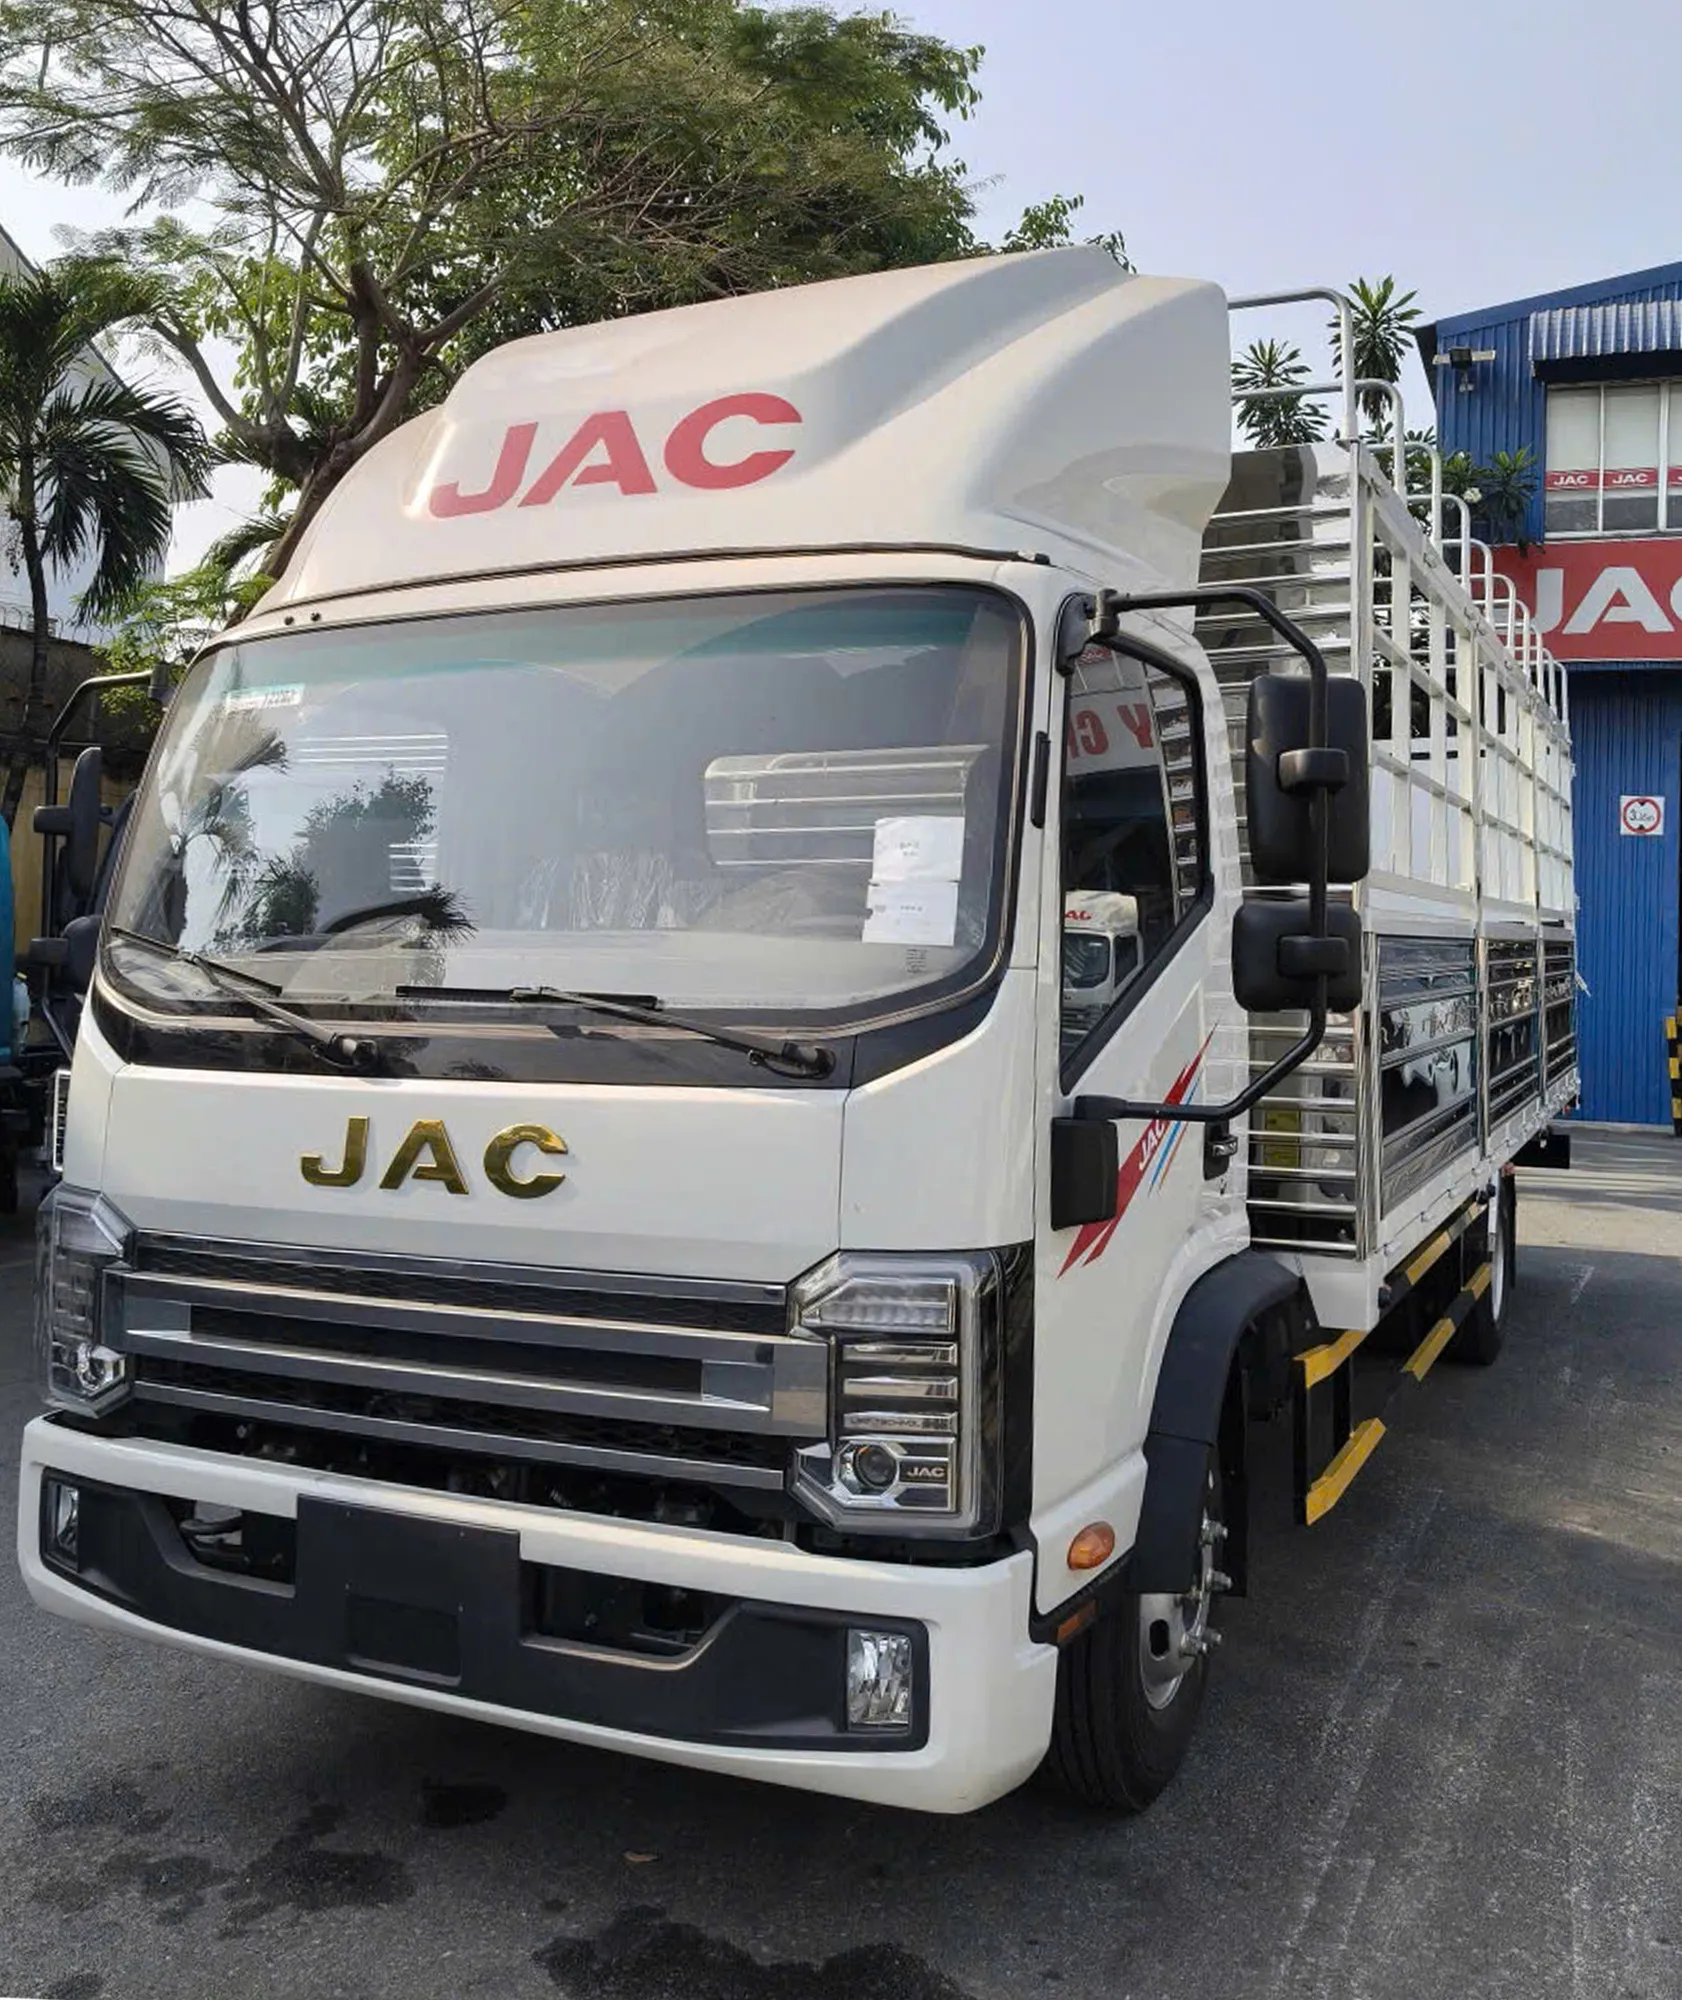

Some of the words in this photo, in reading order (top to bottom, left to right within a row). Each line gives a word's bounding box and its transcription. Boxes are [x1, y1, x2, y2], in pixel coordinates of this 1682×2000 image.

[429, 391, 803, 519] JAC
[1553, 475, 1589, 486] JAC
[1611, 473, 1649, 484] JAC
[1494, 566, 1682, 634] JA
[300, 1116, 568, 1199] JAC
[907, 1466, 945, 1479] JAC
